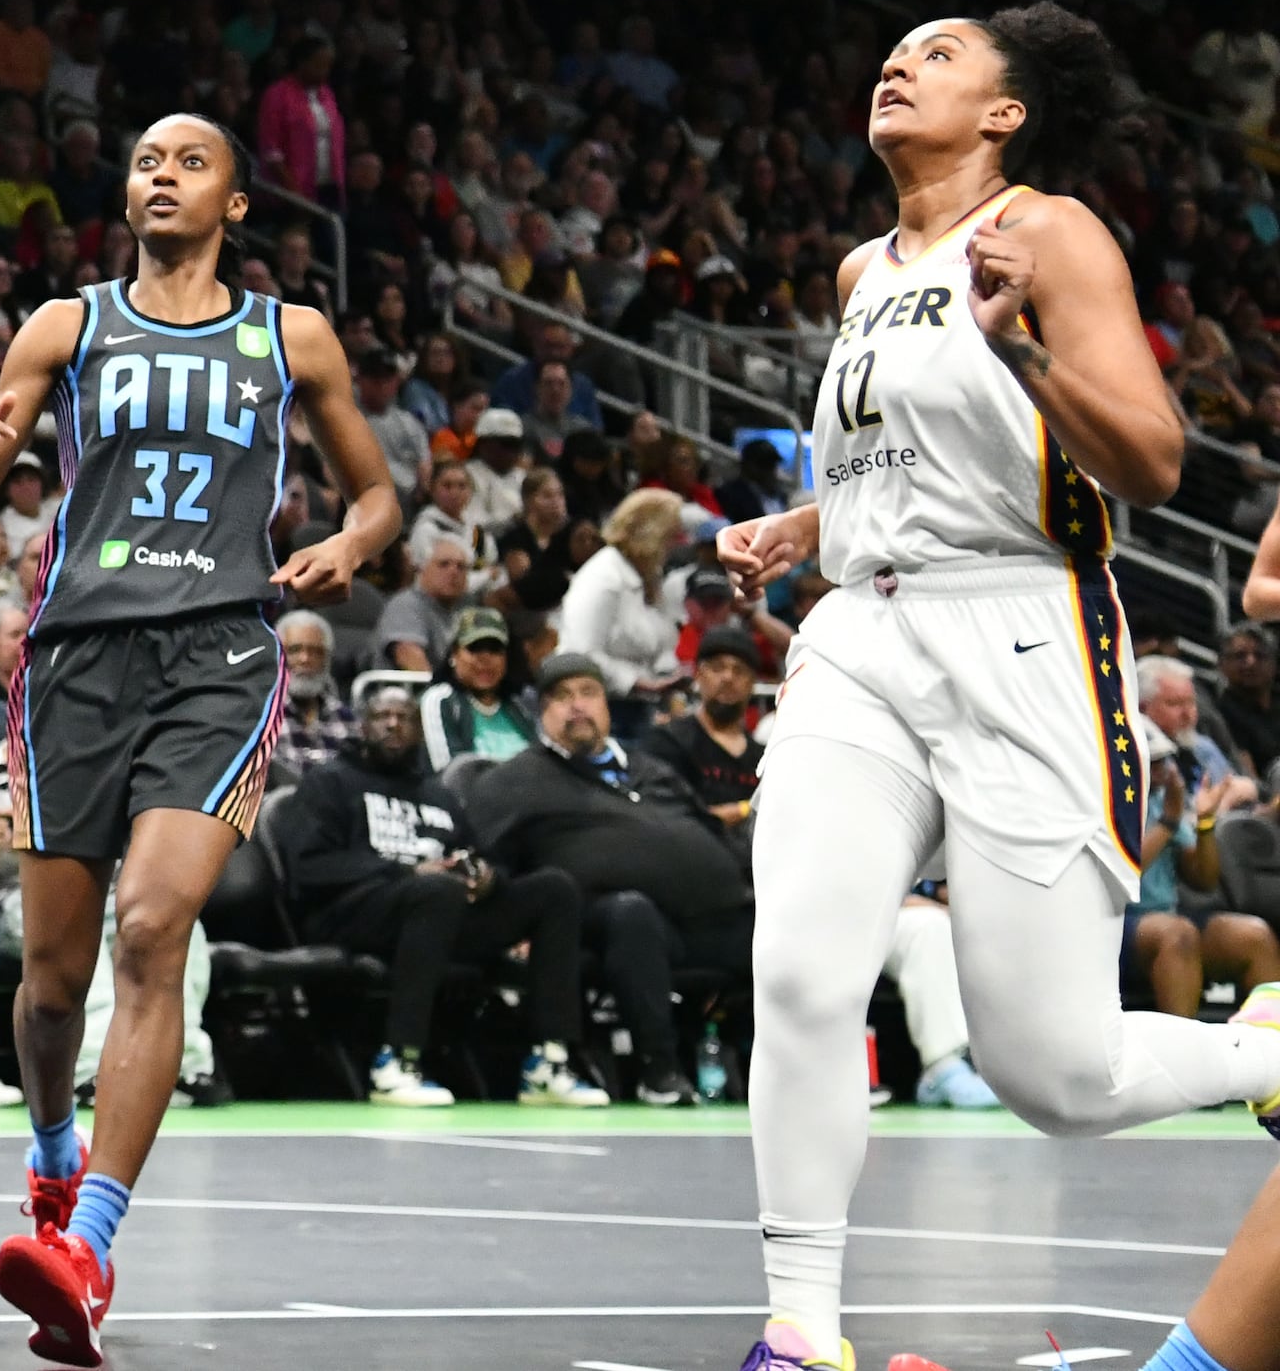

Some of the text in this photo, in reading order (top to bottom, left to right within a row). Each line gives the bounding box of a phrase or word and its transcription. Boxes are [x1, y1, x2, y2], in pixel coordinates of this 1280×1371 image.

[99, 353, 256, 449] ATL
[836, 350, 884, 433] 12
[131, 449, 213, 523] 32
[134, 546, 216, 573] Cash App
